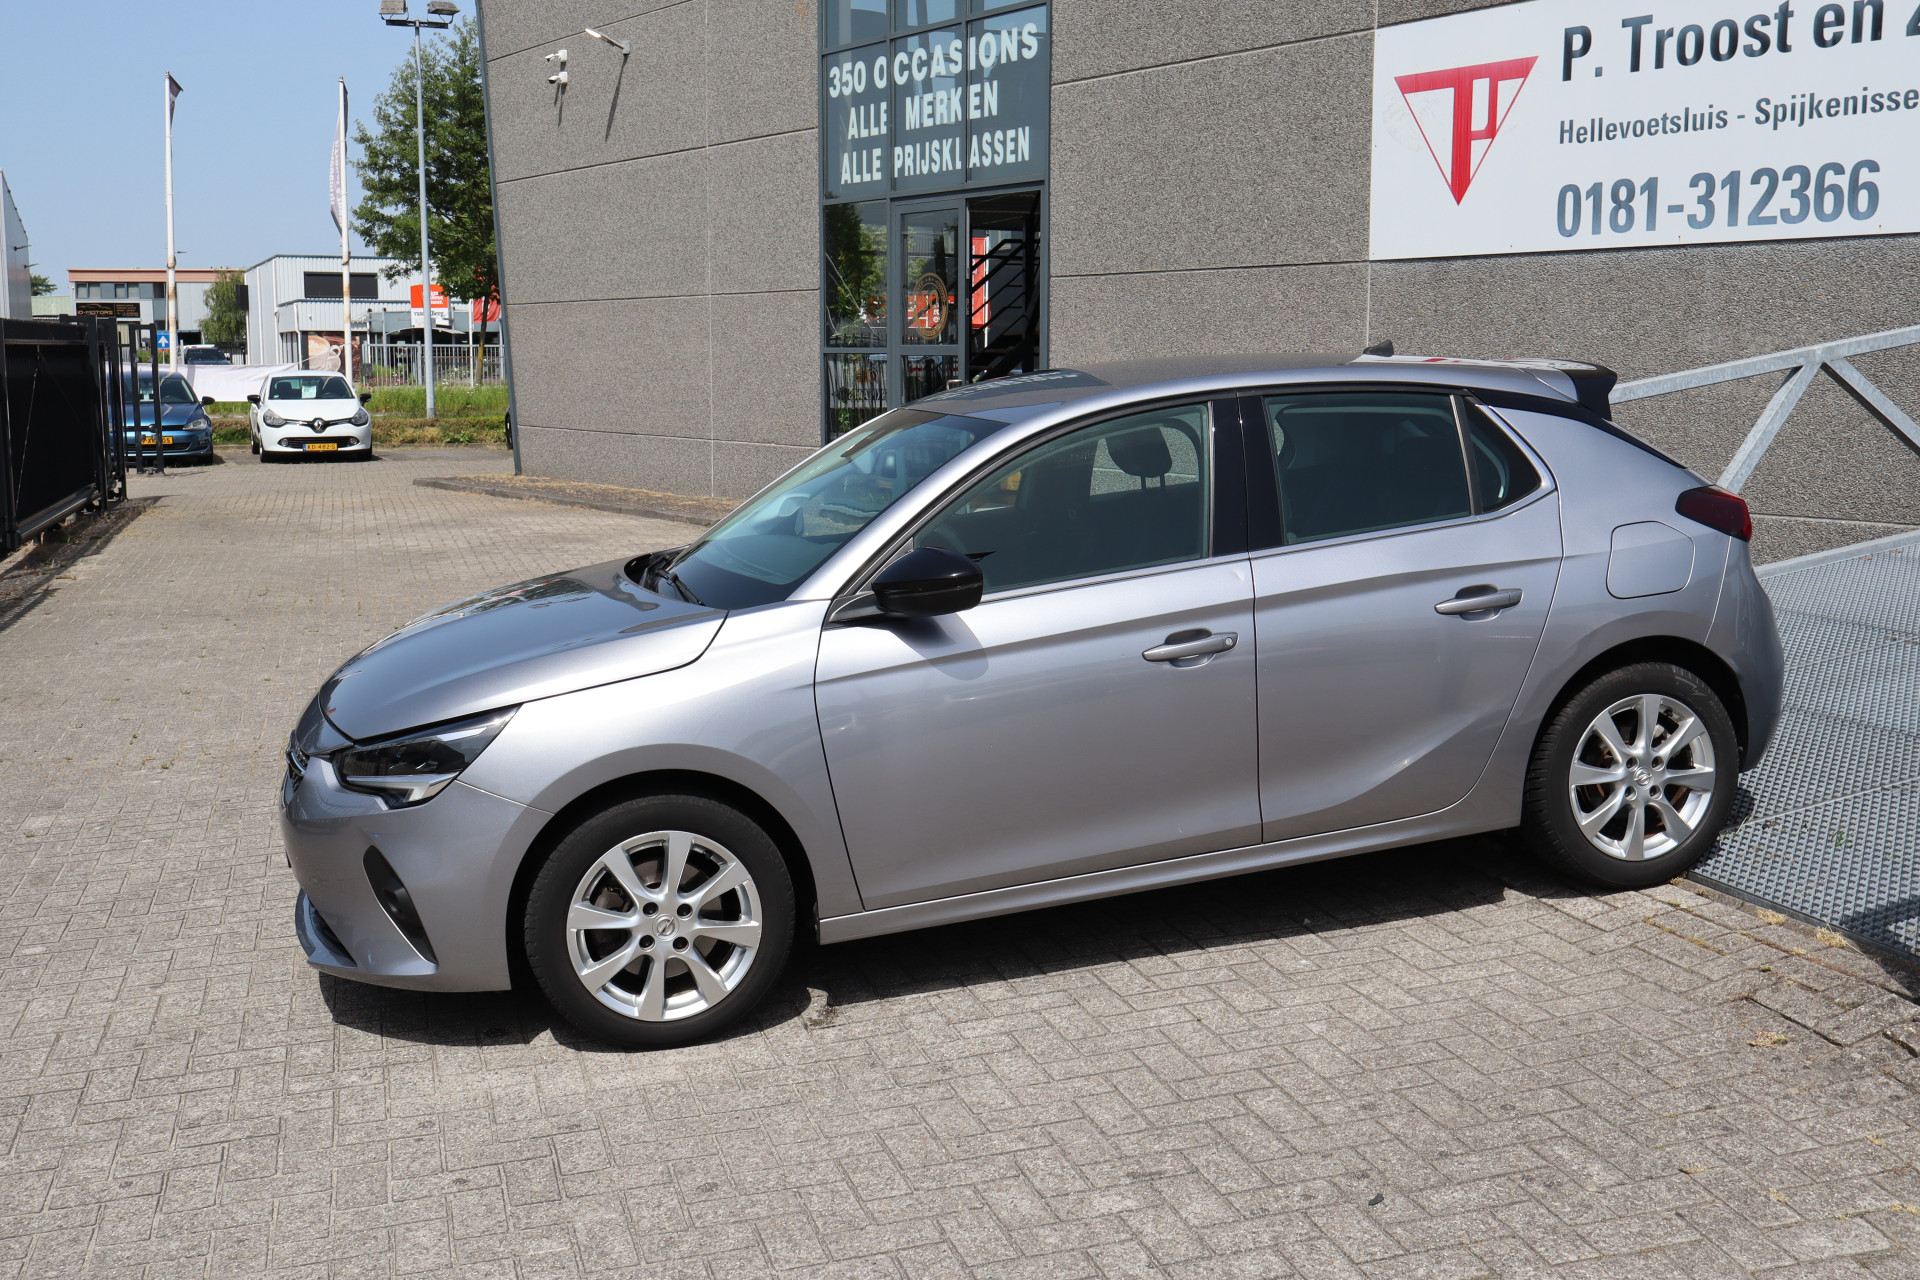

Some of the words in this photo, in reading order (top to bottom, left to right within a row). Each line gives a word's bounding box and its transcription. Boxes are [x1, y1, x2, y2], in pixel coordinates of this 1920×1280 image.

[829, 61, 867, 98] 350
[873, 22, 1038, 89] OCCASIONS
[1562, 25, 1603, 82] P.
[1621, 0, 1794, 73] Troost
[1813, 0, 1884, 49] en
[847, 101, 887, 140] ALLE
[905, 80, 998, 131] MERKEN
[1559, 104, 1728, 145] Hellevoetsluis
[1754, 86, 1919, 131] Spijkenisse
[841, 148, 882, 185] ALLE
[894, 126, 1030, 178] PRIJSKLASSEN
[1557, 159, 1880, 238] 0181-312366
